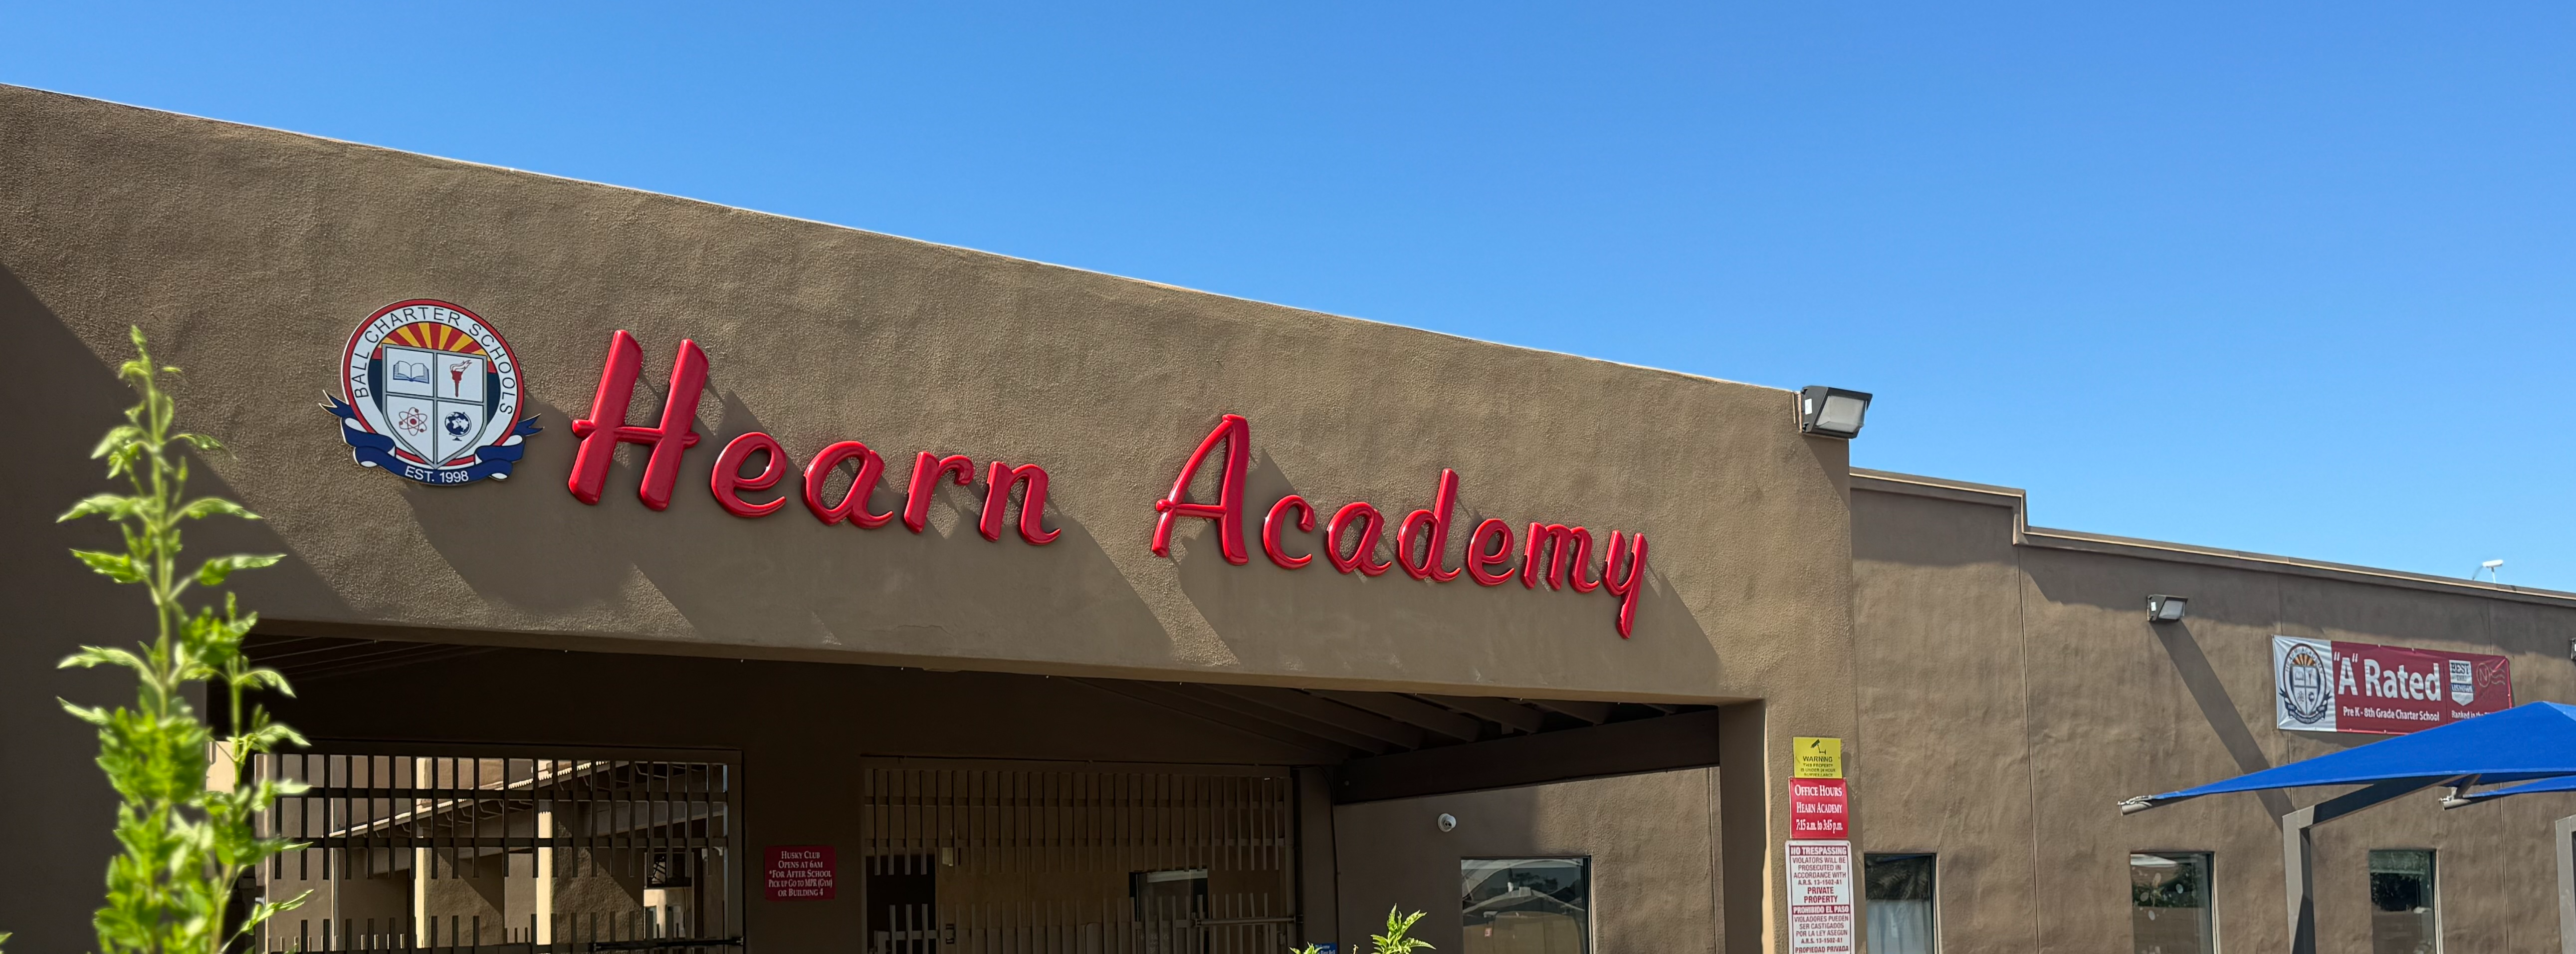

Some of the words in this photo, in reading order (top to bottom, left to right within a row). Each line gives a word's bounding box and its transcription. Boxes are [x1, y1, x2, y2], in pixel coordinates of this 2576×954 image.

[352, 351, 370, 398] BALL
[365, 307, 460, 344] CHARTER
[469, 323, 516, 415] SCHOOLS
[405, 467, 434, 482] EST.
[439, 471, 469, 483] 1998
[568, 329, 1062, 546] Hearn
[1151, 413, 1648, 640] Academy
[2450, 663, 2469, 674] BEST
[2363, 659, 2441, 701] Rated
[2344, 706, 2354, 717] Pre
[2355, 707, 2360, 717] K
[2364, 708, 2375, 718] 8th
[2376, 709, 2395, 719] Grade
[2395, 710, 2419, 720] Charter
[2419, 711, 2439, 721] School
[1817, 820, 1822, 830] to
[1791, 846, 1801, 855] NO
[1801, 846, 1847, 855] TRESPASSING
[1793, 906, 1825, 914] PROHIBIDO
